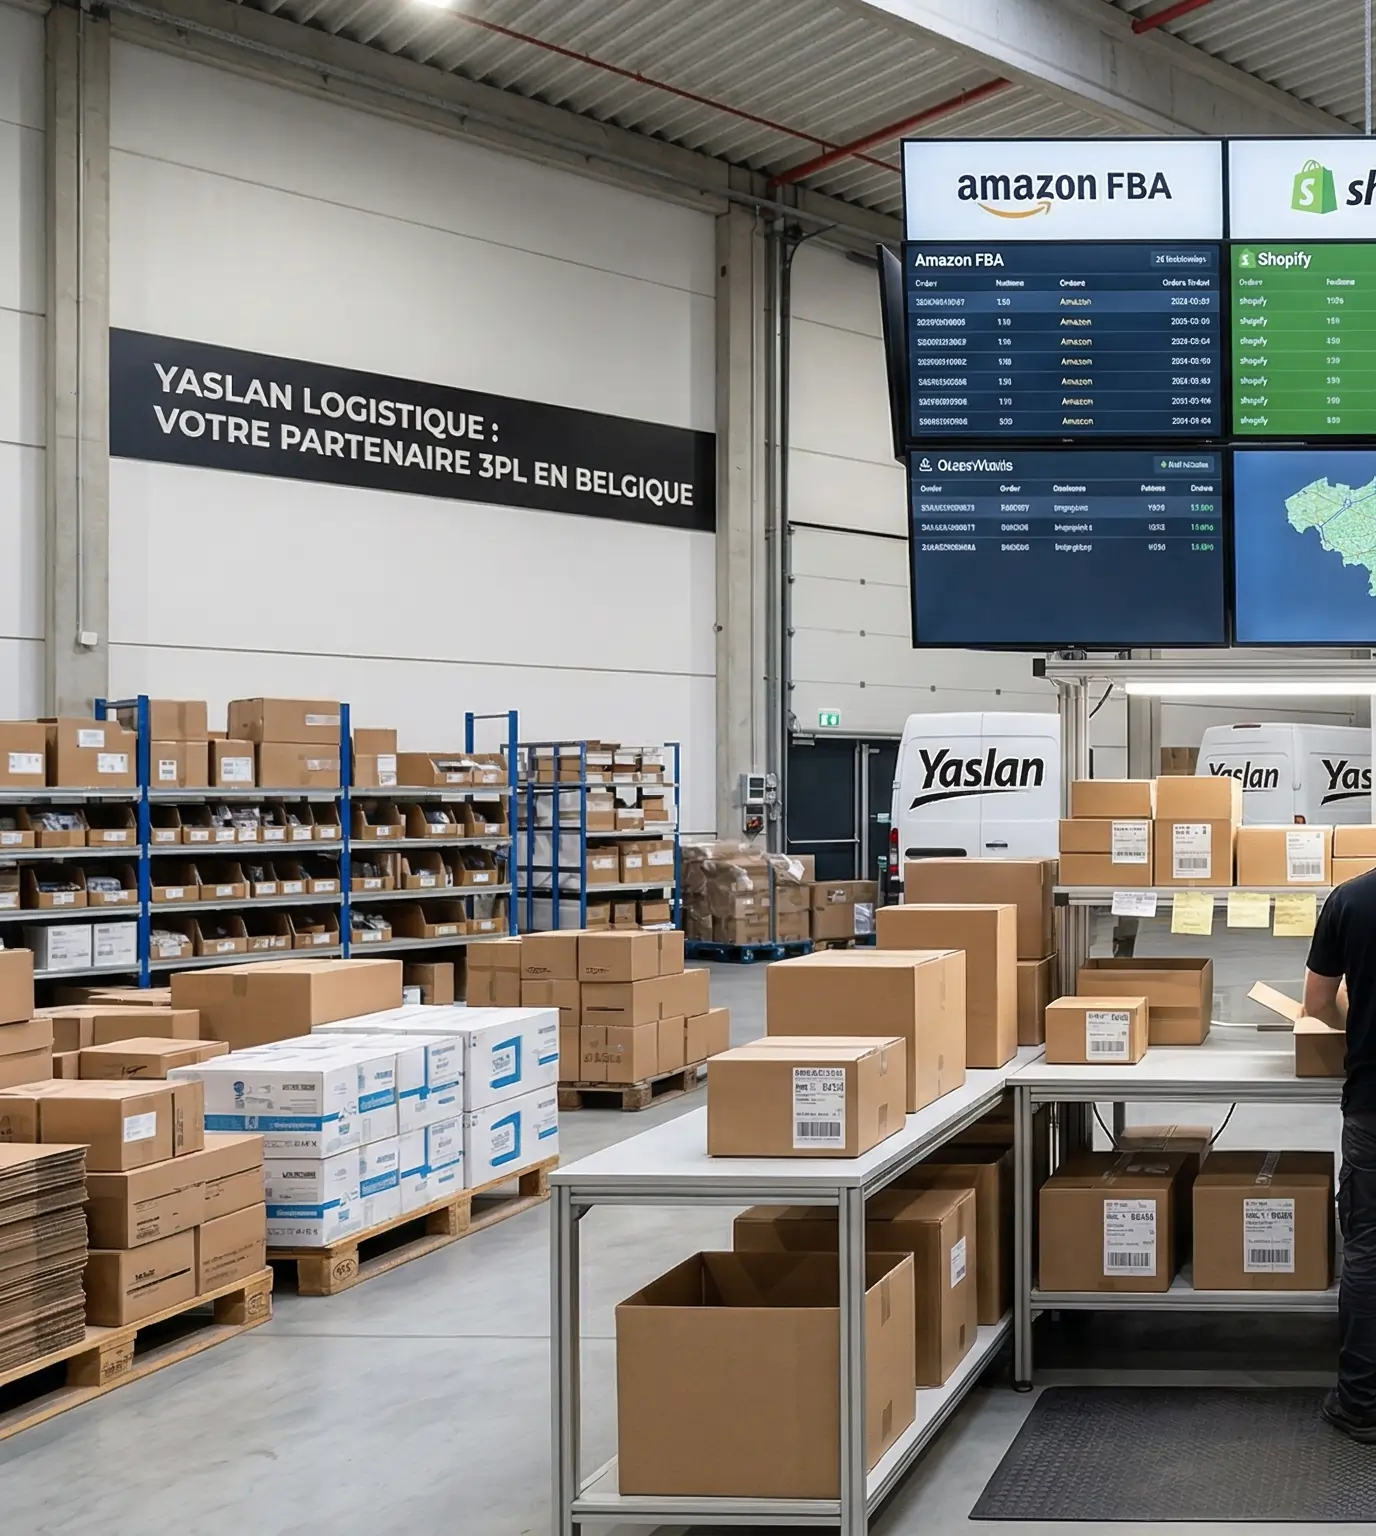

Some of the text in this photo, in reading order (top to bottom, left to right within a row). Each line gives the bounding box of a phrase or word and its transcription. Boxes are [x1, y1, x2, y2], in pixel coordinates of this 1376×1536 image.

[957, 172, 1173, 201] amazon FBA
[915, 253, 1004, 267] Amazon FBA
[1257, 251, 1312, 269] Shopify
[153, 362, 499, 442] YASLAN LOGISTIQUE :
[153, 405, 694, 507] VOTRE PARTENAIRE 3PL EN BELGIQUE
[918, 747, 1045, 790] Yaslan
